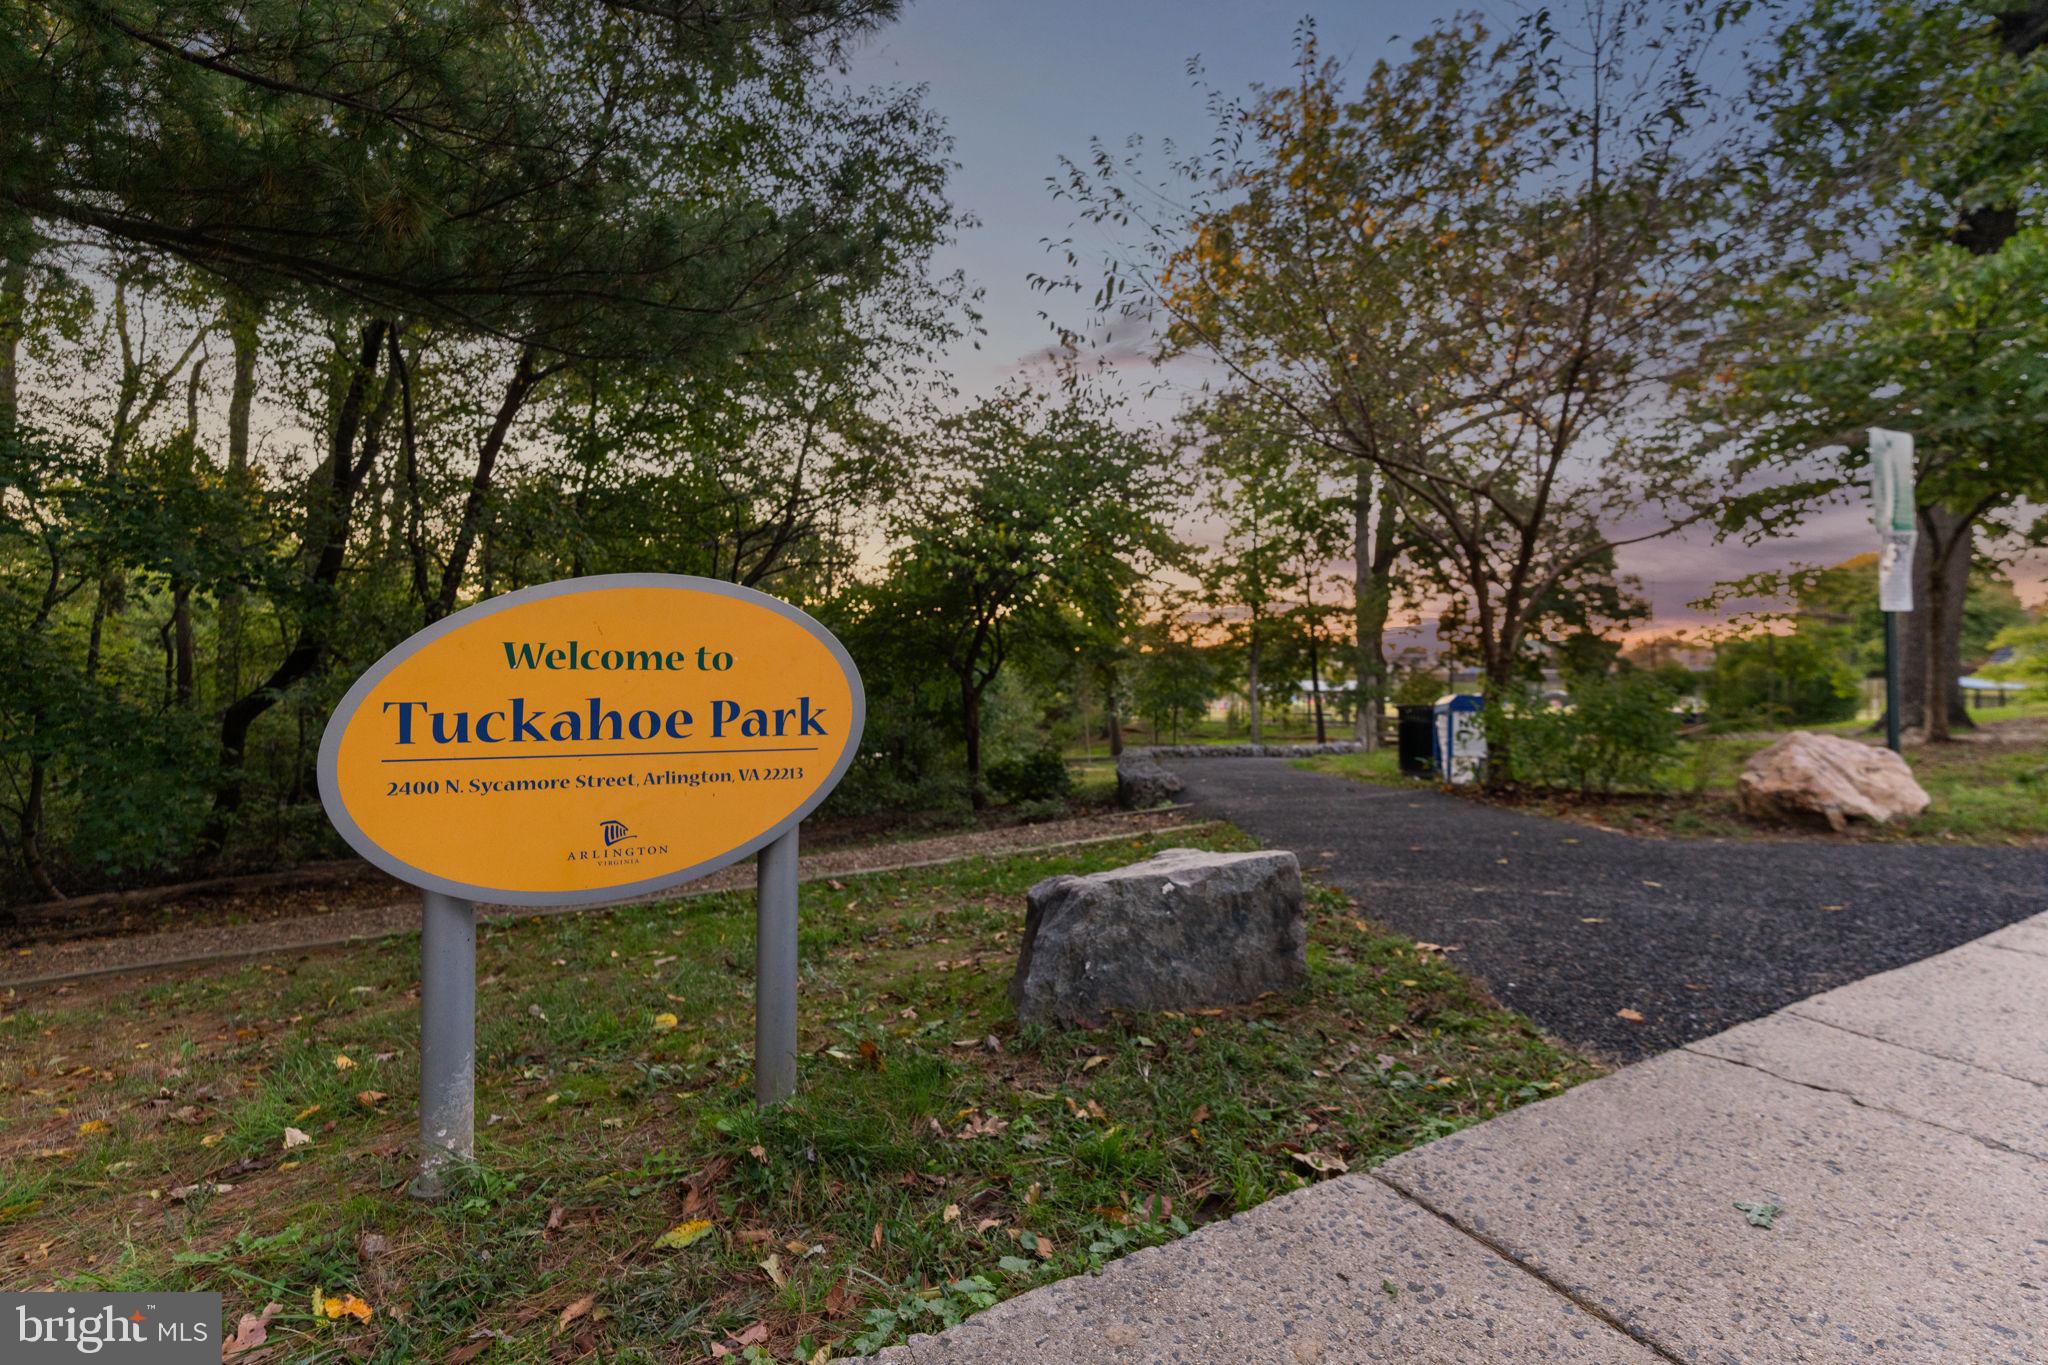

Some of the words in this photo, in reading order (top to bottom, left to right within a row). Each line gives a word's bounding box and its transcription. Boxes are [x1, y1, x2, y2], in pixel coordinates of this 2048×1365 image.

[502, 640, 685, 672] Welcome
[694, 646, 734, 672] to
[383, 697, 694, 745] Tuckahoe
[709, 696, 829, 739] Park
[386, 780, 440, 797] 2400
[445, 779, 465, 794] N.
[469, 778, 571, 797] Sycamore
[575, 773, 640, 788] Street,
[643, 770, 735, 787] Arlington,
[738, 768, 760, 782] VA
[763, 767, 805, 781] 22213
[567, 845, 668, 861] ARLINGTON
[597, 858, 640, 867] VIRGINIA
